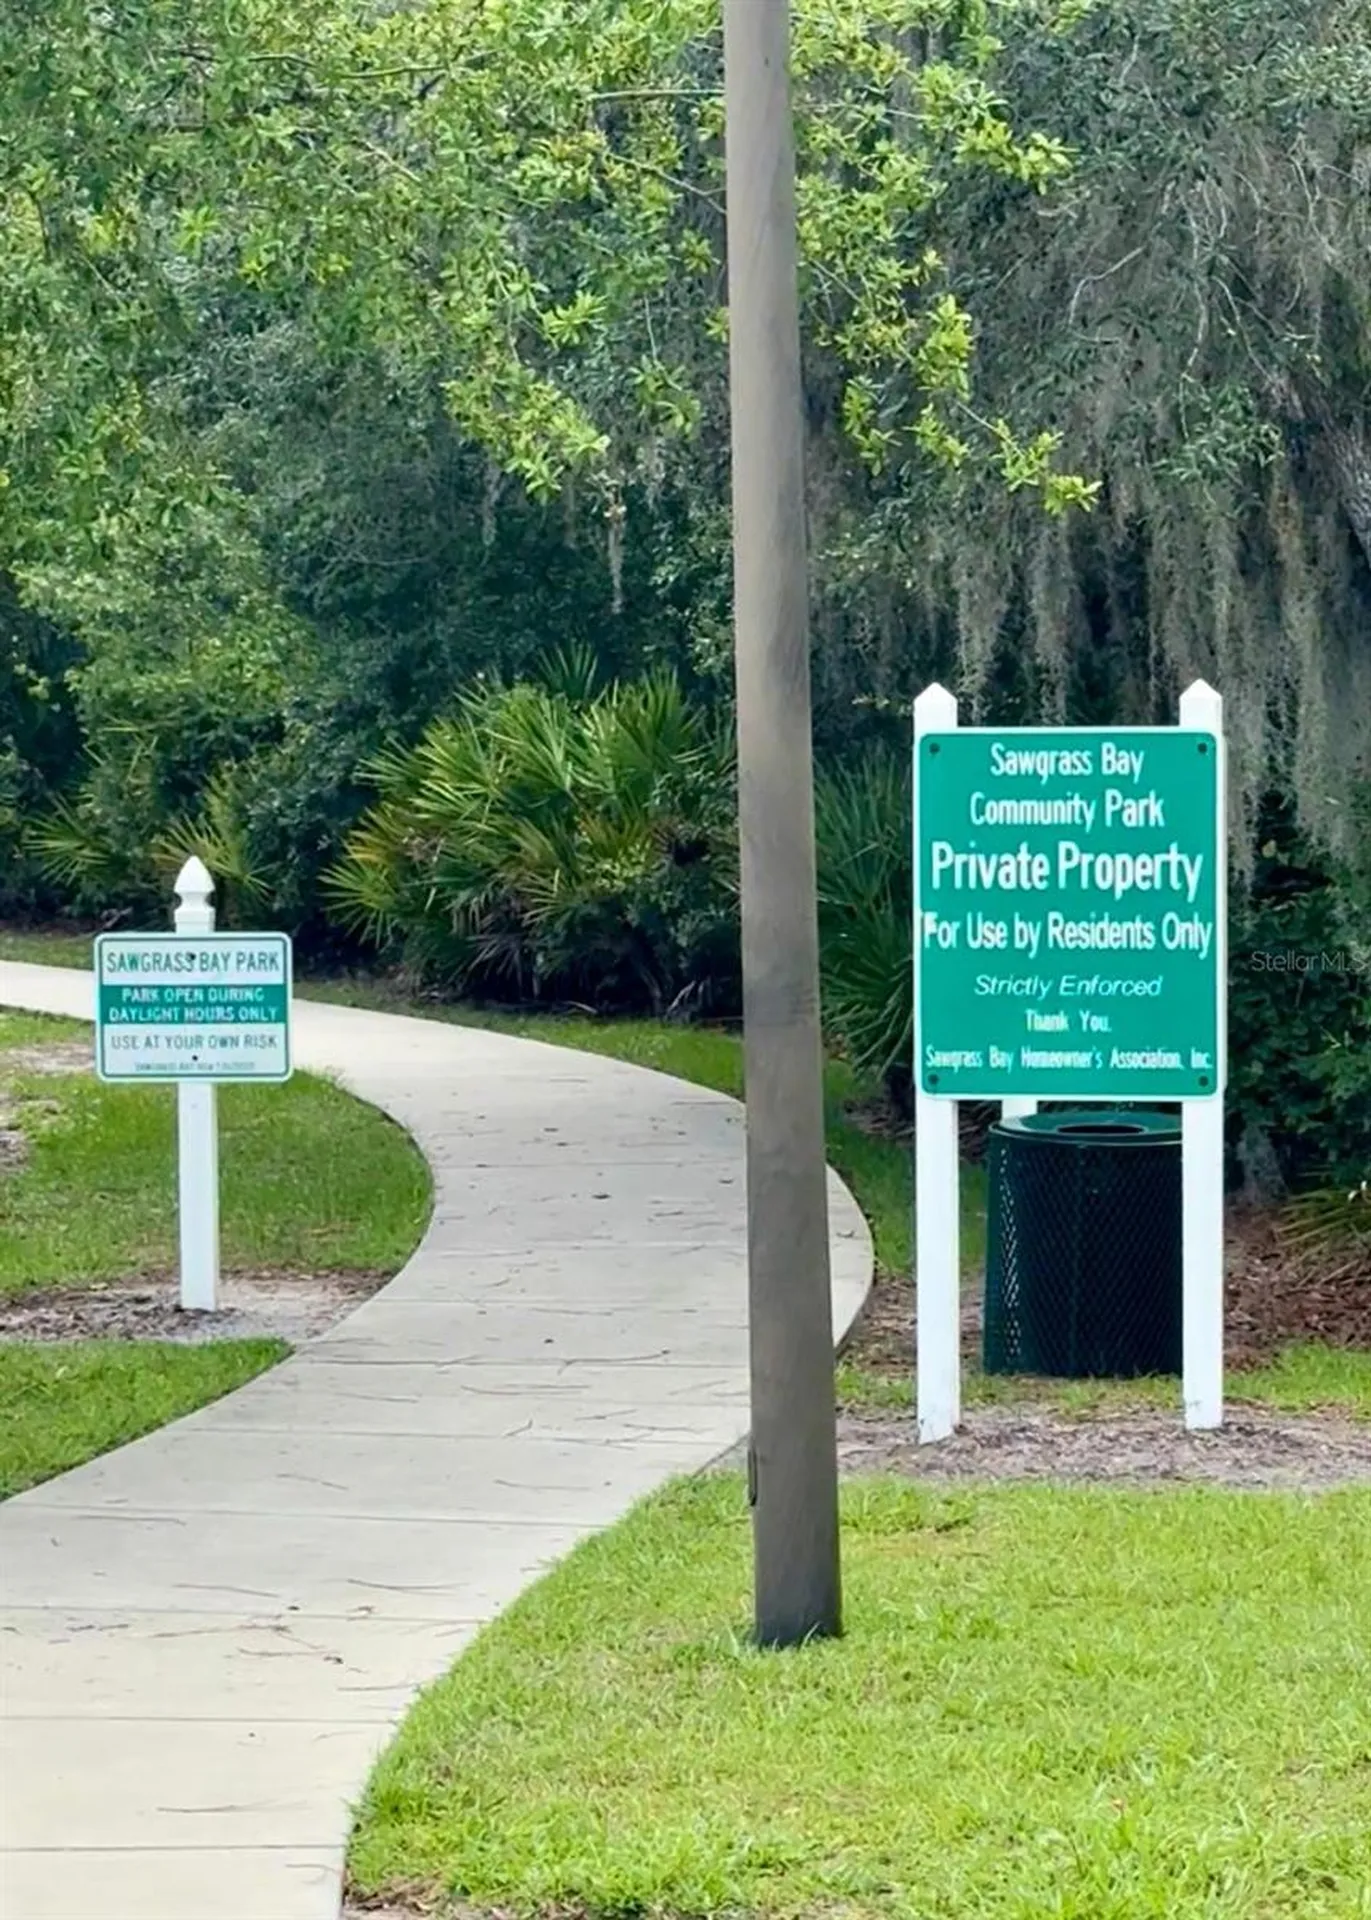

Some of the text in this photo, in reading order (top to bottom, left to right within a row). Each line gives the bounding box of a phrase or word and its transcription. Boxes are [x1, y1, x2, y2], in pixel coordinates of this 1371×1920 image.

[990, 742, 1145, 784] Sawgrass Bay
[970, 789, 1164, 833] Community Park
[931, 841, 1204, 902] Private Property
[923, 911, 1212, 960] For Use by Residents Only
[107, 952, 280, 972] SAWGRASS BAY PARK
[122, 988, 264, 1003] PARK OPEN DURING
[974, 975, 1163, 1000] Strictly Enforced
[109, 1006, 278, 1021] DAYLIGHT HOURS ONLY
[1026, 1010, 1069, 1032] Thank
[111, 1035, 277, 1050] USE AT YOUR OWN RISK
[926, 1048, 983, 1073] Sawgrass
[989, 1046, 1013, 1073] Bay
